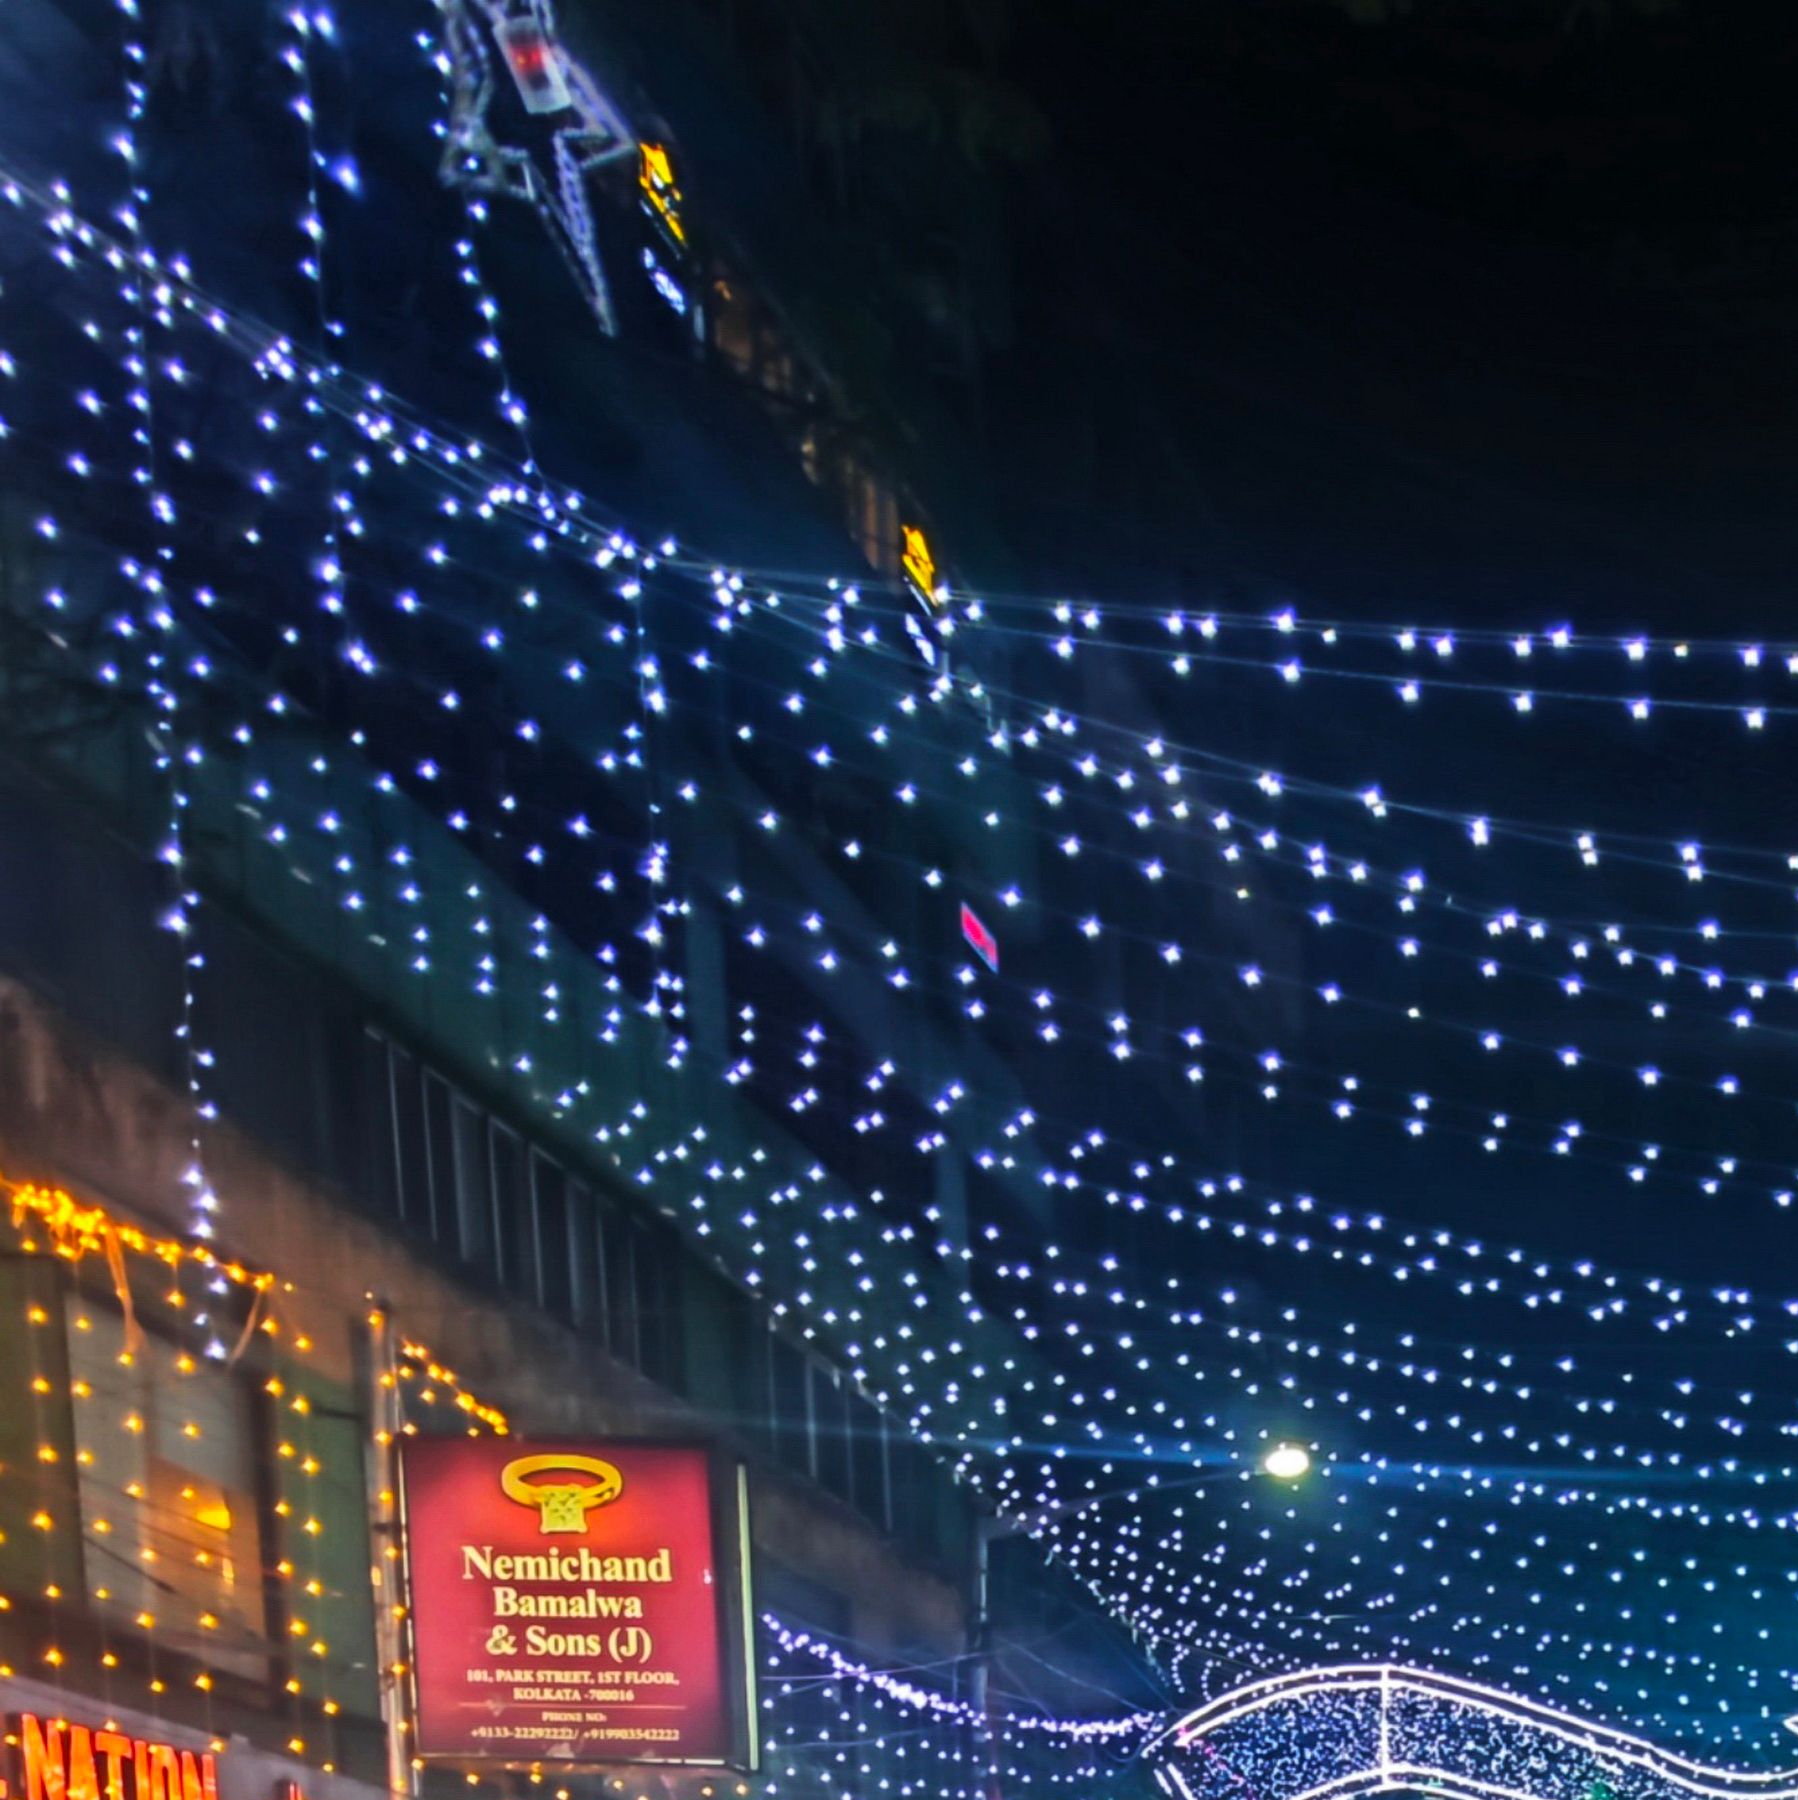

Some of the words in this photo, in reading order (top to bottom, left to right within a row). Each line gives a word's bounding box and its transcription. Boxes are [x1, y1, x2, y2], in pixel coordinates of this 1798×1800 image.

[461, 1546, 672, 1582] Nemichand
[493, 1586, 643, 1618] Bamalwa
[485, 1624, 518, 1656] &
[525, 1625, 601, 1656] Sons
[608, 1627, 652, 1663] (J)
[496, 1669, 534, 1683] PARK
[536, 1670, 595, 1684] STREET,
[597, 1671, 621, 1684] 1ST
[624, 1671, 680, 1685] FLOOR,
[513, 1687, 582, 1701] KOLKATA
